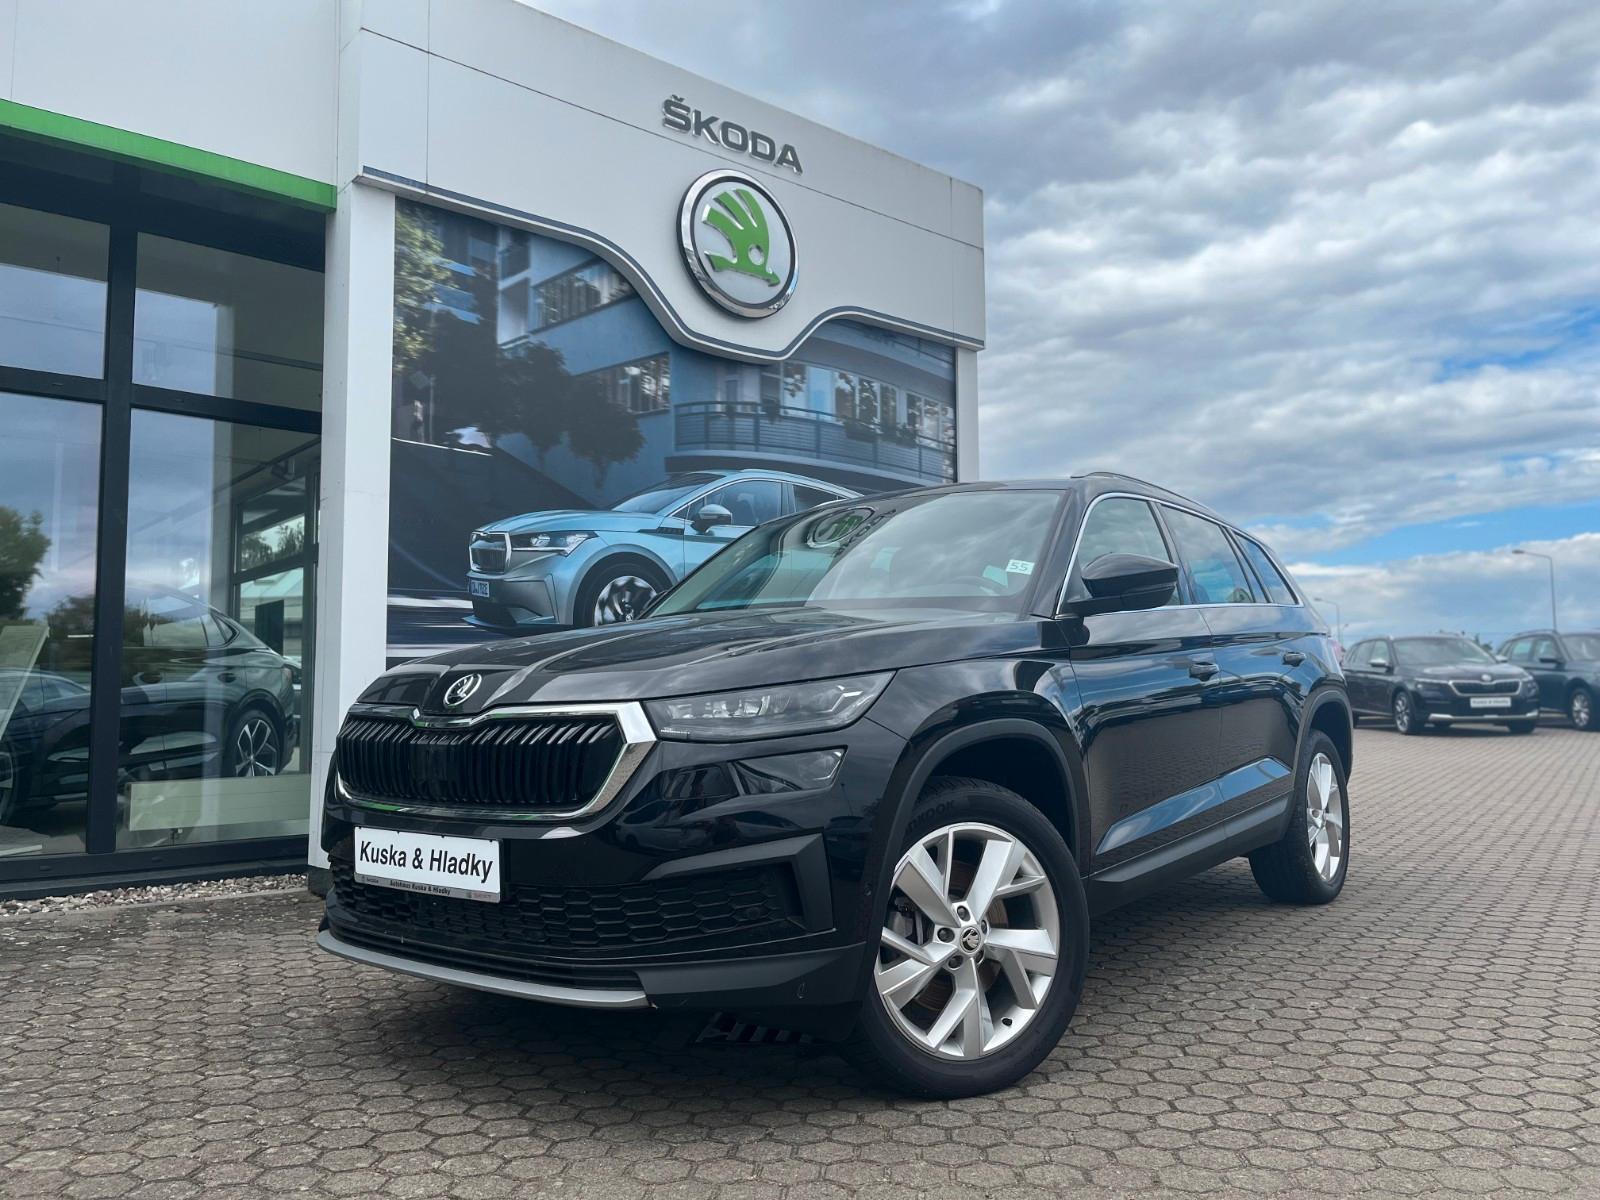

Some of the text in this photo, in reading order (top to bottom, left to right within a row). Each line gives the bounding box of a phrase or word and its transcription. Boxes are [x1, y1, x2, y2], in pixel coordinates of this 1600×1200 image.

[662, 94, 803, 175] ŠKODA
[360, 840, 493, 884] Kuska & Hladky
